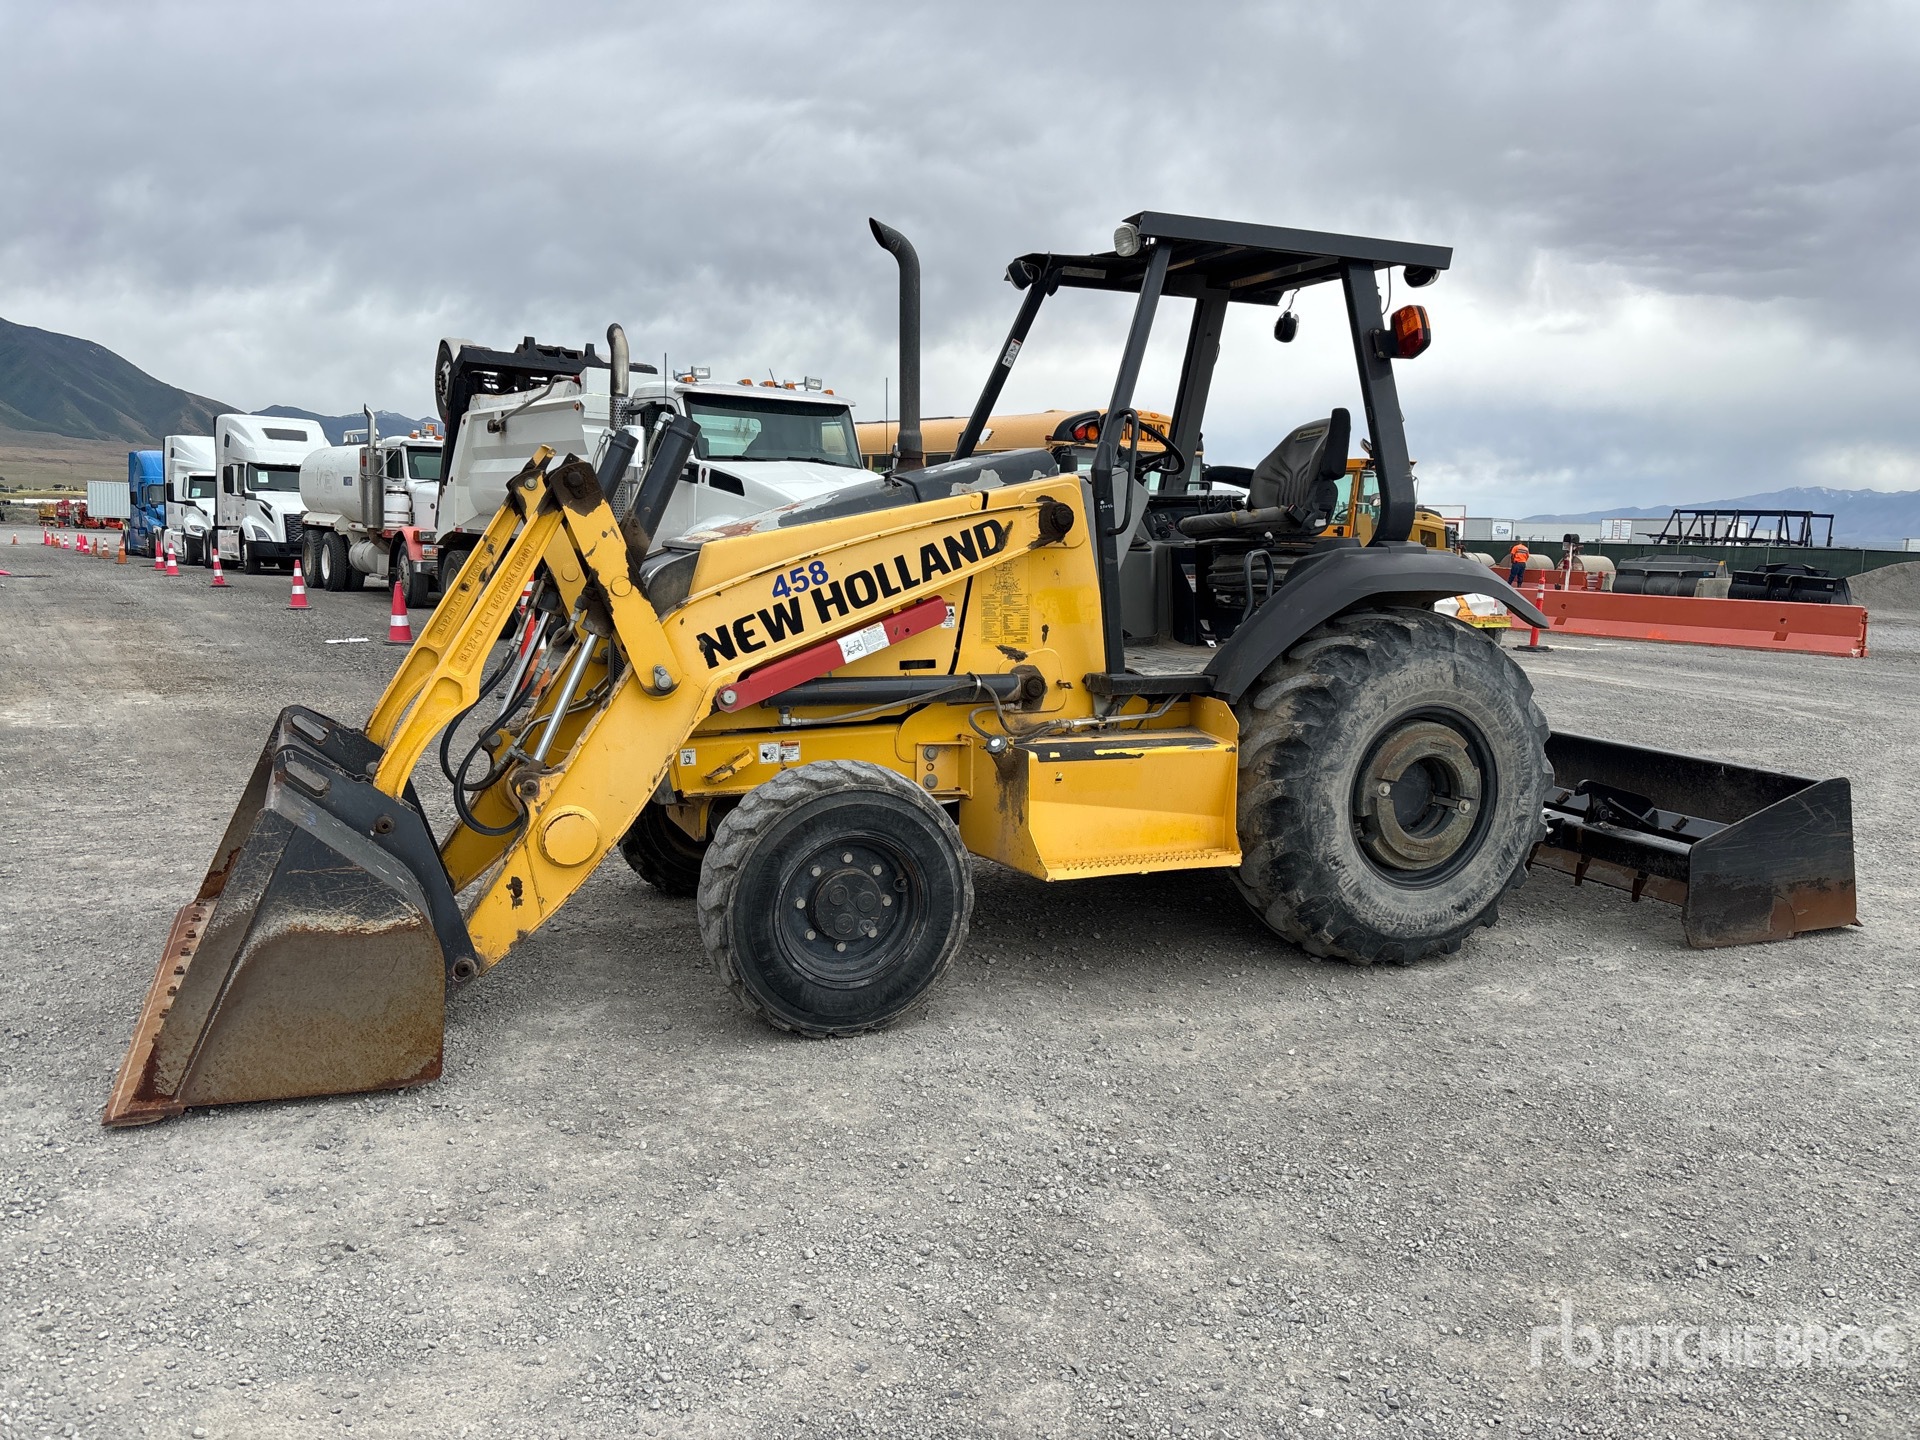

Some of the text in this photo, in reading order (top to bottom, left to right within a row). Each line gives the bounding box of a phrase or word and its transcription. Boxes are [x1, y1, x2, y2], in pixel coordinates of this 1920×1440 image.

[696, 596, 804, 669] NEW
[810, 519, 1007, 624] HOLLAND
[771, 560, 830, 599] 458
